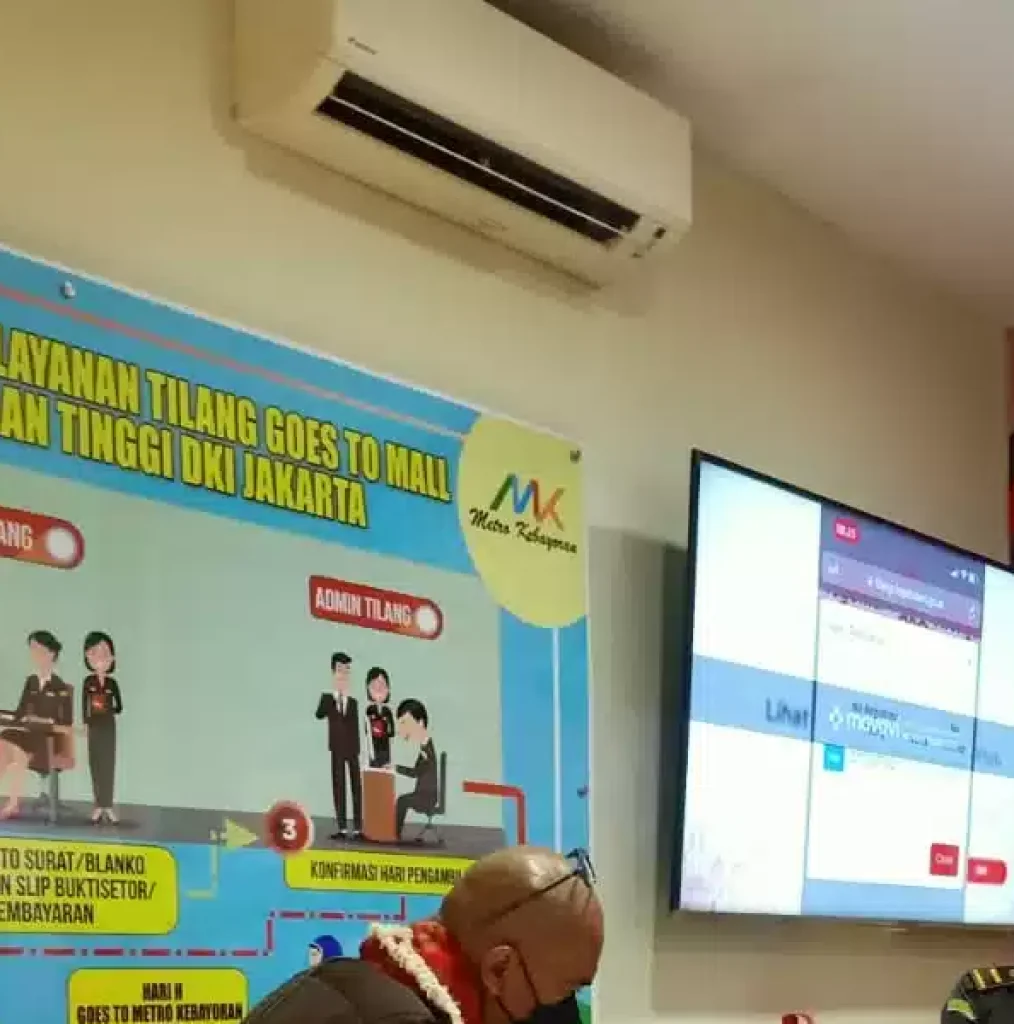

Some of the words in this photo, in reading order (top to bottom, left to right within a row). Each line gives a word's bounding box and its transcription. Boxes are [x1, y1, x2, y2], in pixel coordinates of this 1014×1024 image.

[146, 369, 258, 448] TILANG
[264, 406, 340, 471] GOES
[344, 428, 380, 482] TO
[384, 440, 452, 503] MALL
[57, 401, 173, 480] TINGGI
[181, 434, 236, 496] DKI
[242, 451, 368, 529] JAKARTA
[469, 508, 510, 534] Metro
[515, 521, 577, 553] Kebayoran
[315, 586, 361, 616] ADMIN
[364, 597, 412, 628] TILANG
[282, 818, 297, 841] 3
[24, 848, 145, 875] SURAT/BLANKO
[310, 859, 379, 881] KONFIRMASI
[380, 865, 406, 883] HARI
[16, 874, 51, 897] SLIP
[55, 876, 157, 900] BUKTISETOR/
[142, 983, 172, 1001] HARI
[174, 983, 183, 1001] H
[77, 1004, 110, 1024] GOES
[113, 1004, 129, 1024] TO
[132, 1004, 173, 1024] METRO
[175, 1002, 243, 1022] KEBAYORAN
